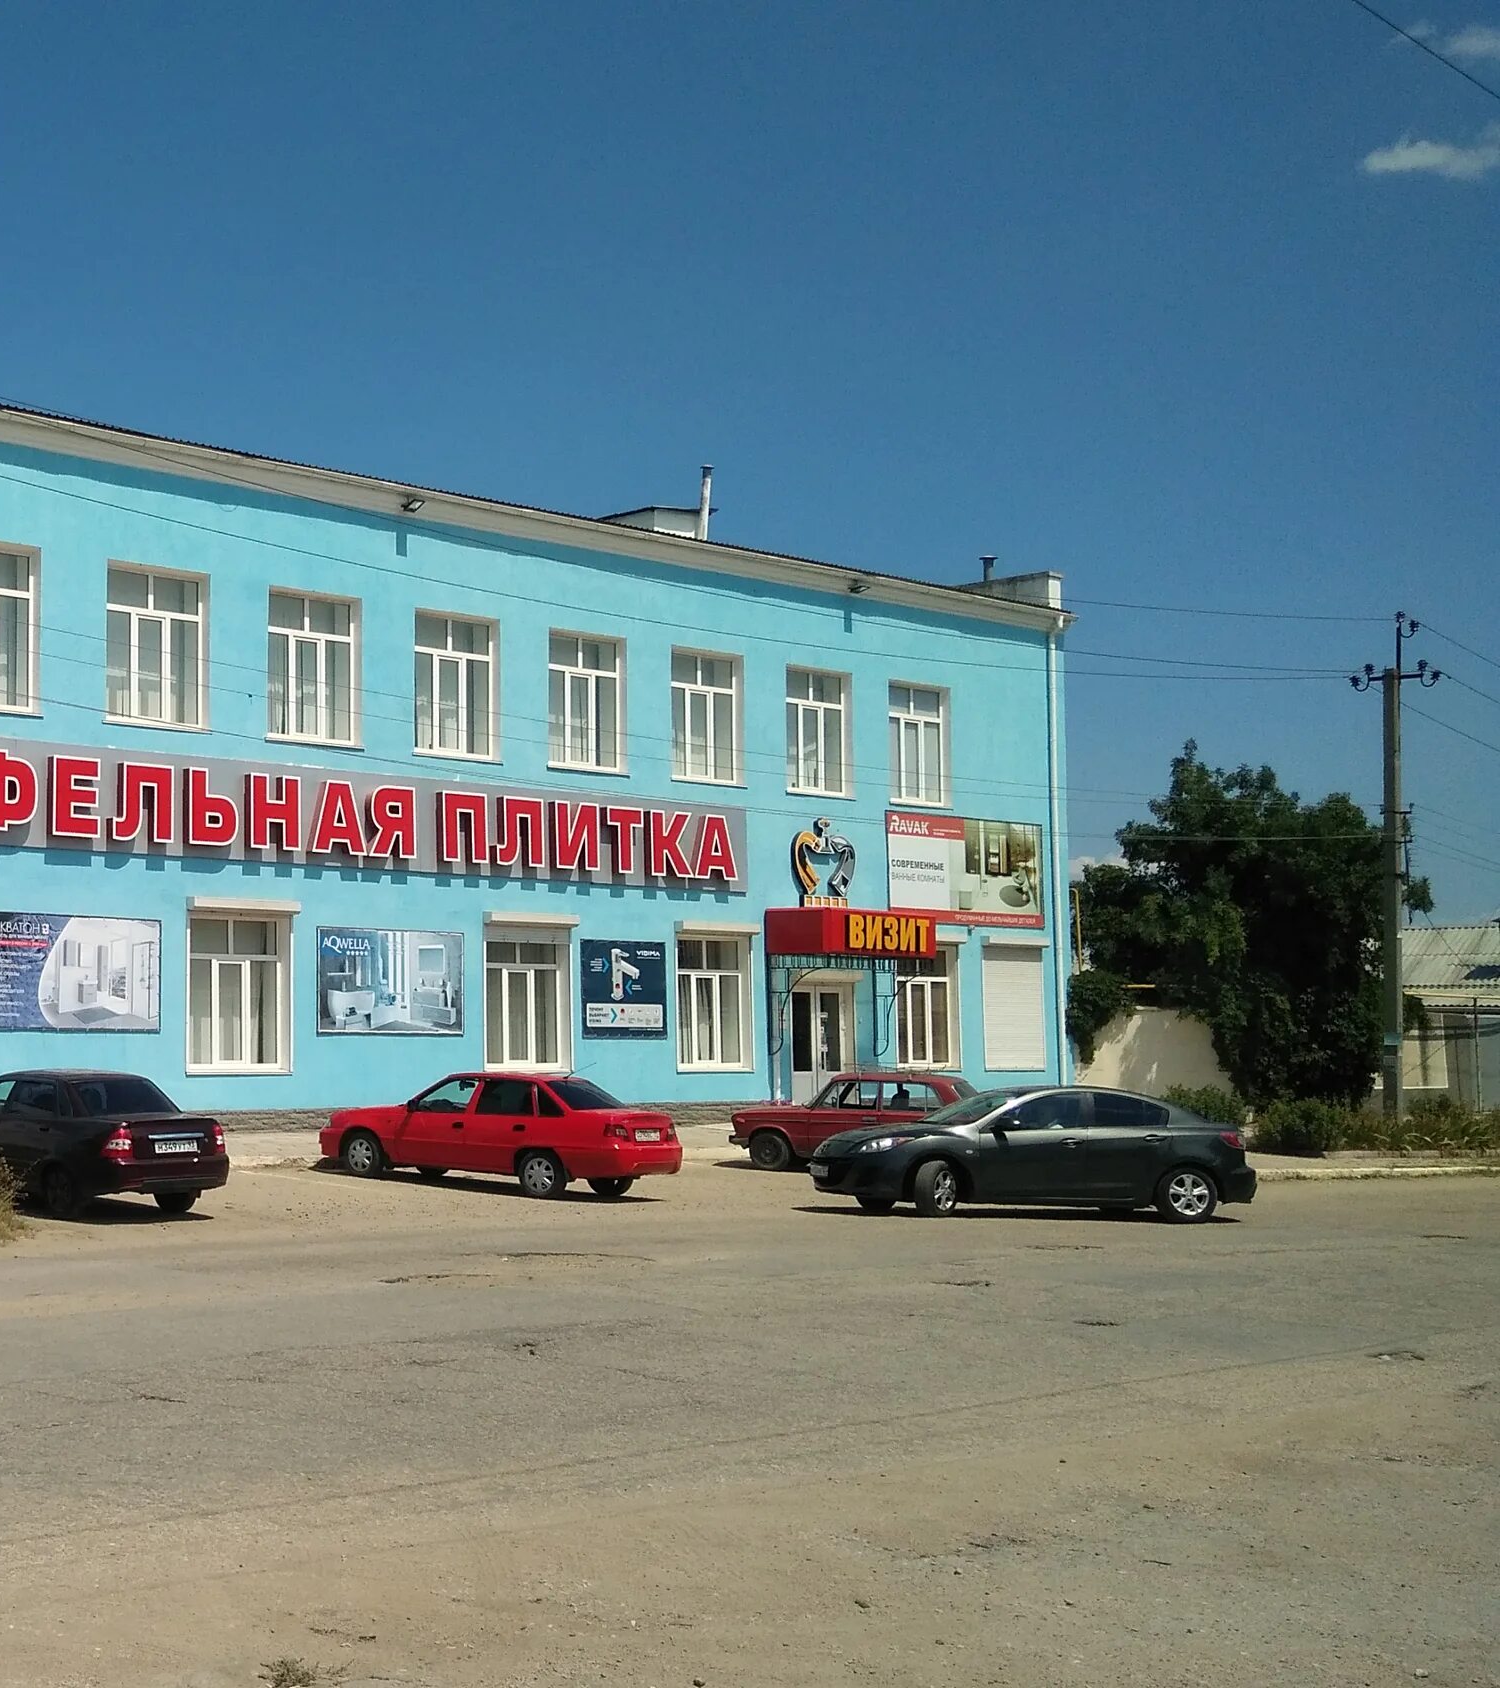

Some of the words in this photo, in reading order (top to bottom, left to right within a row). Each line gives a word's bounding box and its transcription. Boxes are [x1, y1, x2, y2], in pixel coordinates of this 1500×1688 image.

[438, 789, 739, 881] ПЛИТКА
[889, 815, 930, 835] RAVAK
[891, 858, 945, 872] СОВРЕМЕННЫЕ
[848, 913, 931, 953] ВИЗИТ
[322, 935, 371, 953] AQWELLA
